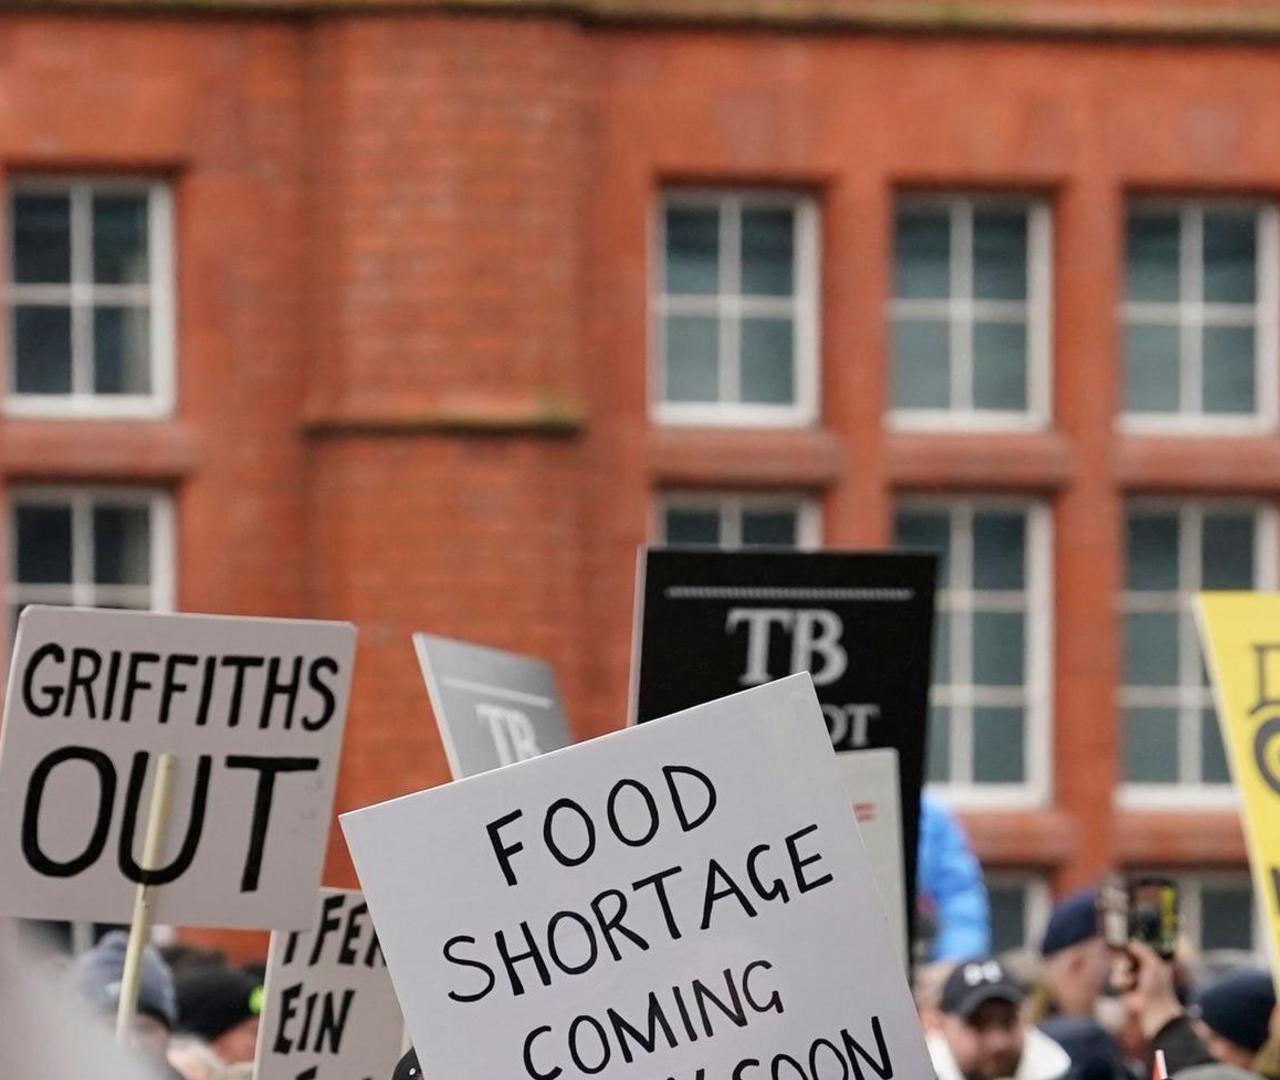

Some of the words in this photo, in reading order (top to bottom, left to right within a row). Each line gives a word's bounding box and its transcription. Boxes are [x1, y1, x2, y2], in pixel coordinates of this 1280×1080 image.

[22, 642, 339, 731] GRIFFITHS
[724, 608, 848, 687] TB
[21, 745, 320, 893] OUT
[486, 765, 717, 886] FOOD
[442, 824, 833, 1002] SHORTAGE
[273, 983, 355, 1054] EIN
